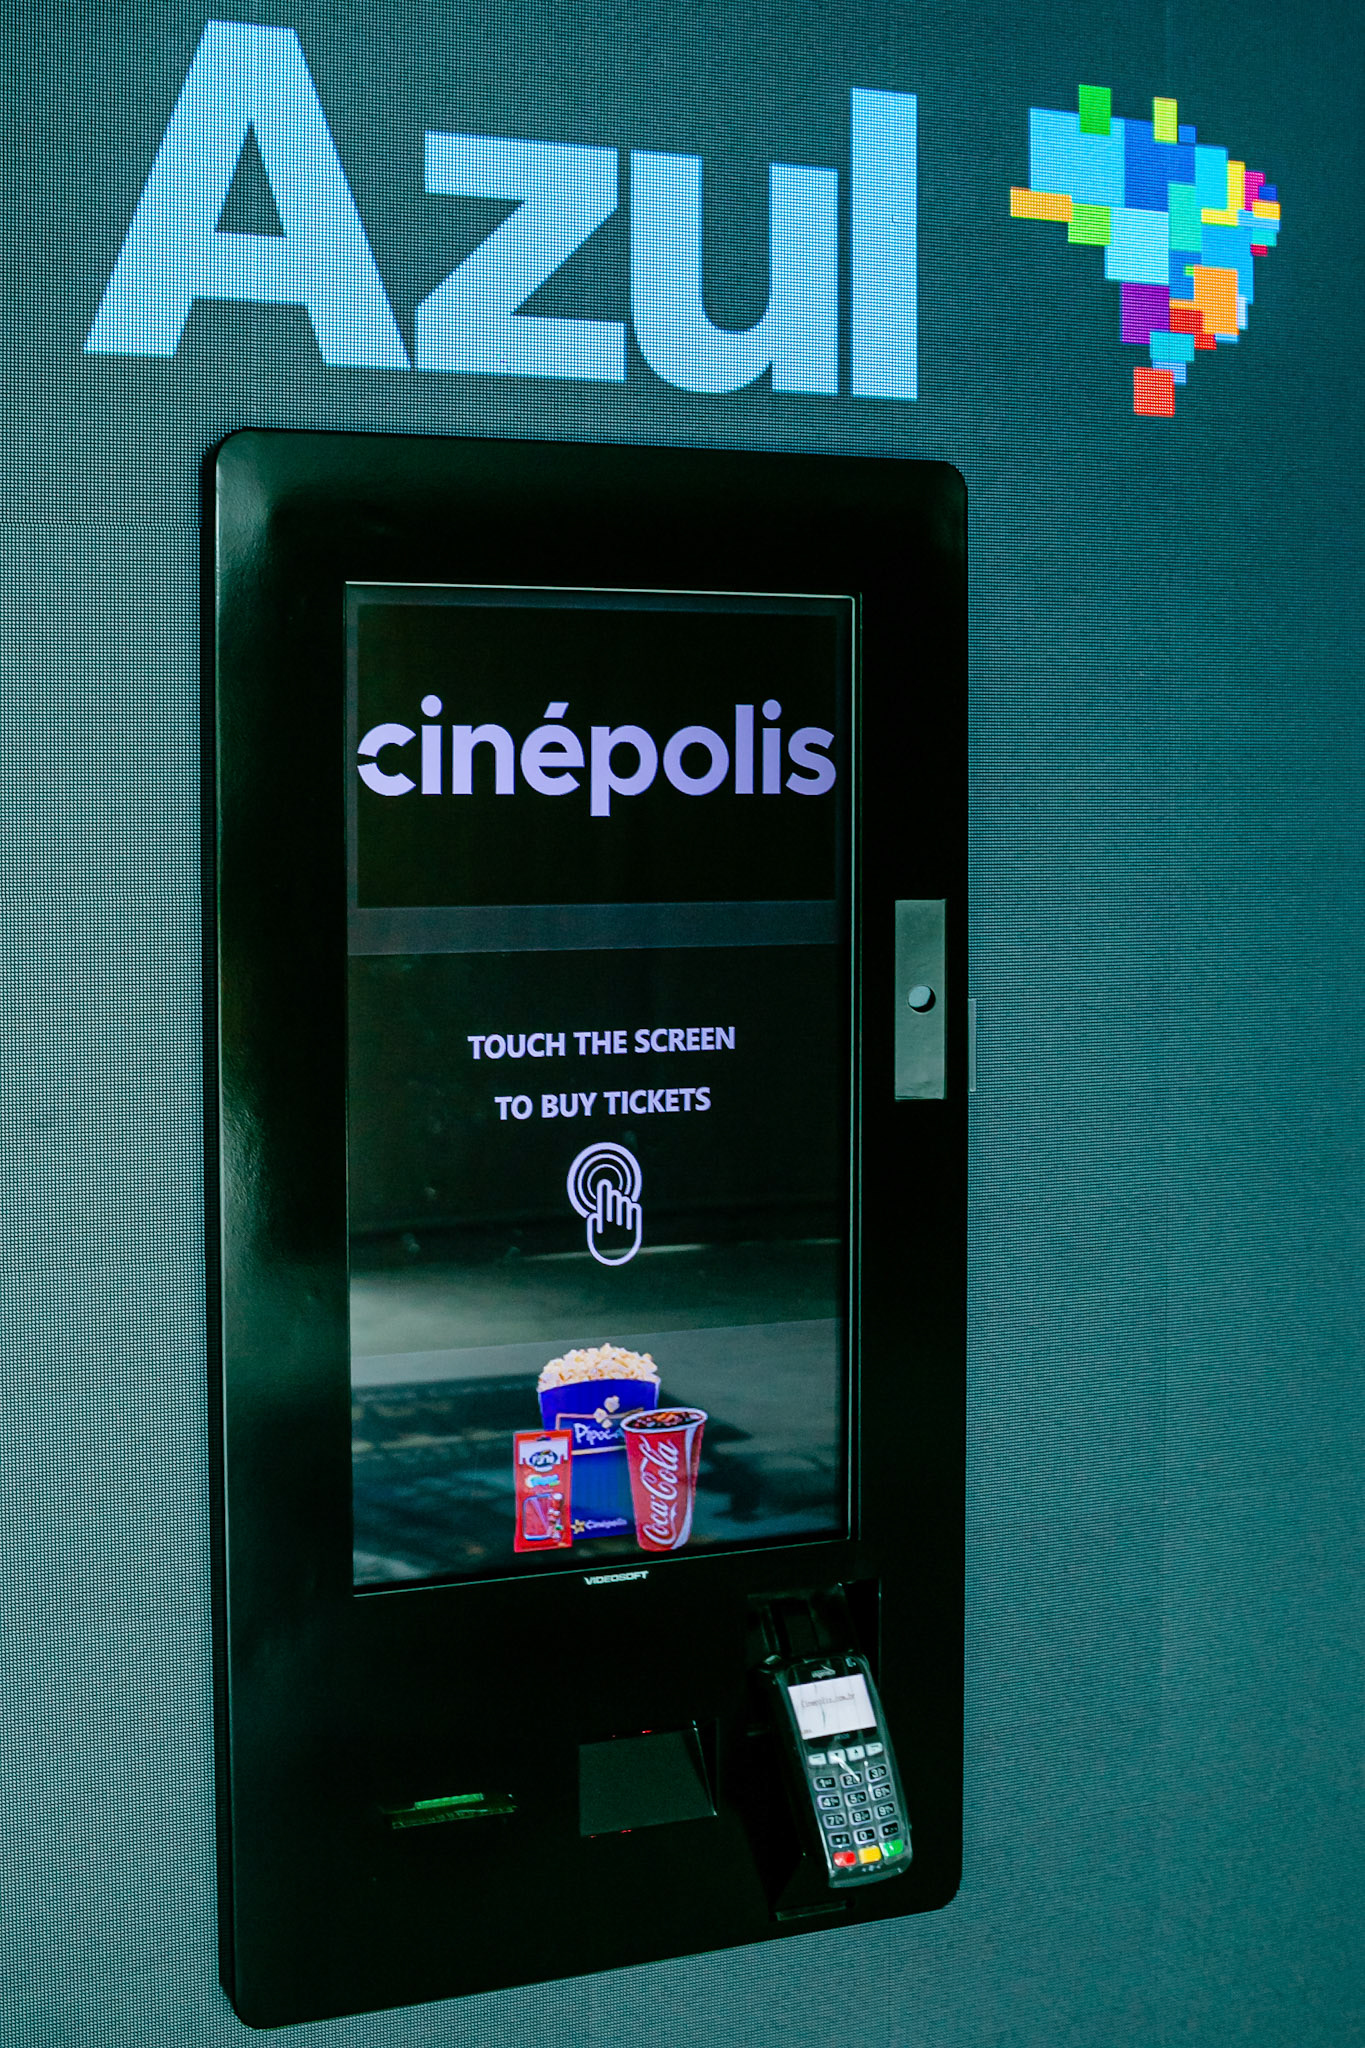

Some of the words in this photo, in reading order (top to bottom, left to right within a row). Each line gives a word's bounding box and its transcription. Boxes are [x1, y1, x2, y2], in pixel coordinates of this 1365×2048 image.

[83, 18, 918, 400] Azul
[357, 694, 837, 817] cinépolis
[467, 1032, 566, 1060] TOUCH
[573, 1030, 628, 1056] THE
[634, 1026, 736, 1053] SCREEN
[494, 1095, 533, 1120] TO
[541, 1092, 598, 1118] BUY
[603, 1087, 712, 1115] TICKETS
[583, 1570, 649, 1585] VIDEOSOFT
